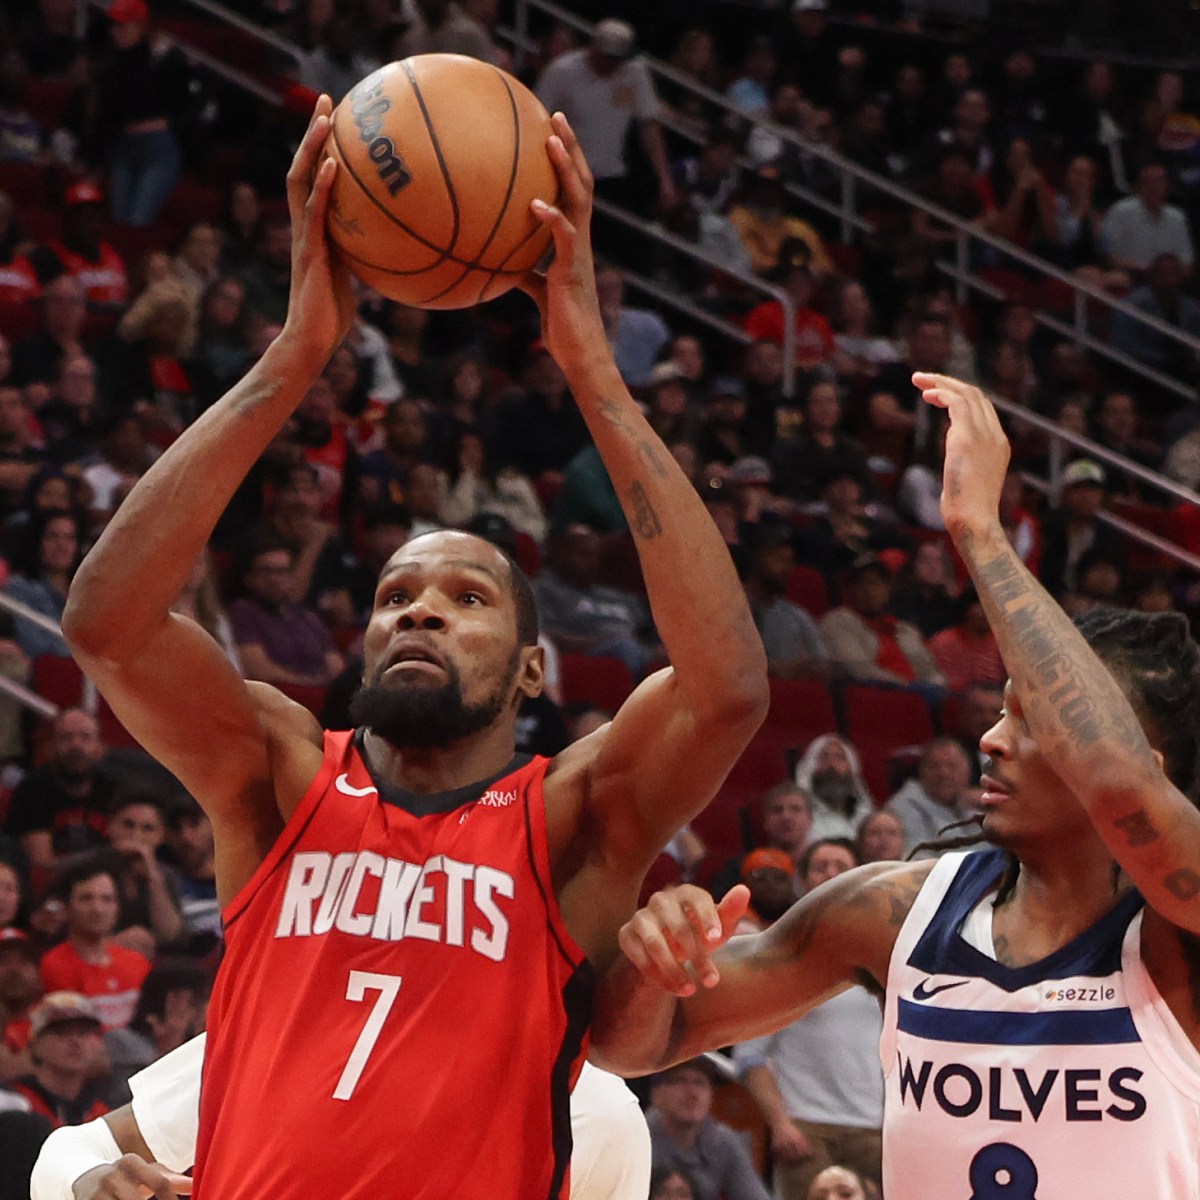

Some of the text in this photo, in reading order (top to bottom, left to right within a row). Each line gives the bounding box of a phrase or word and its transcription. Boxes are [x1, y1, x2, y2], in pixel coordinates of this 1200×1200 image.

[274, 850, 514, 963] ROCKETS
[332, 970, 402, 1101] 7
[1057, 985, 1116, 1001] sezzle
[897, 1050, 1148, 1123] WOLVES
